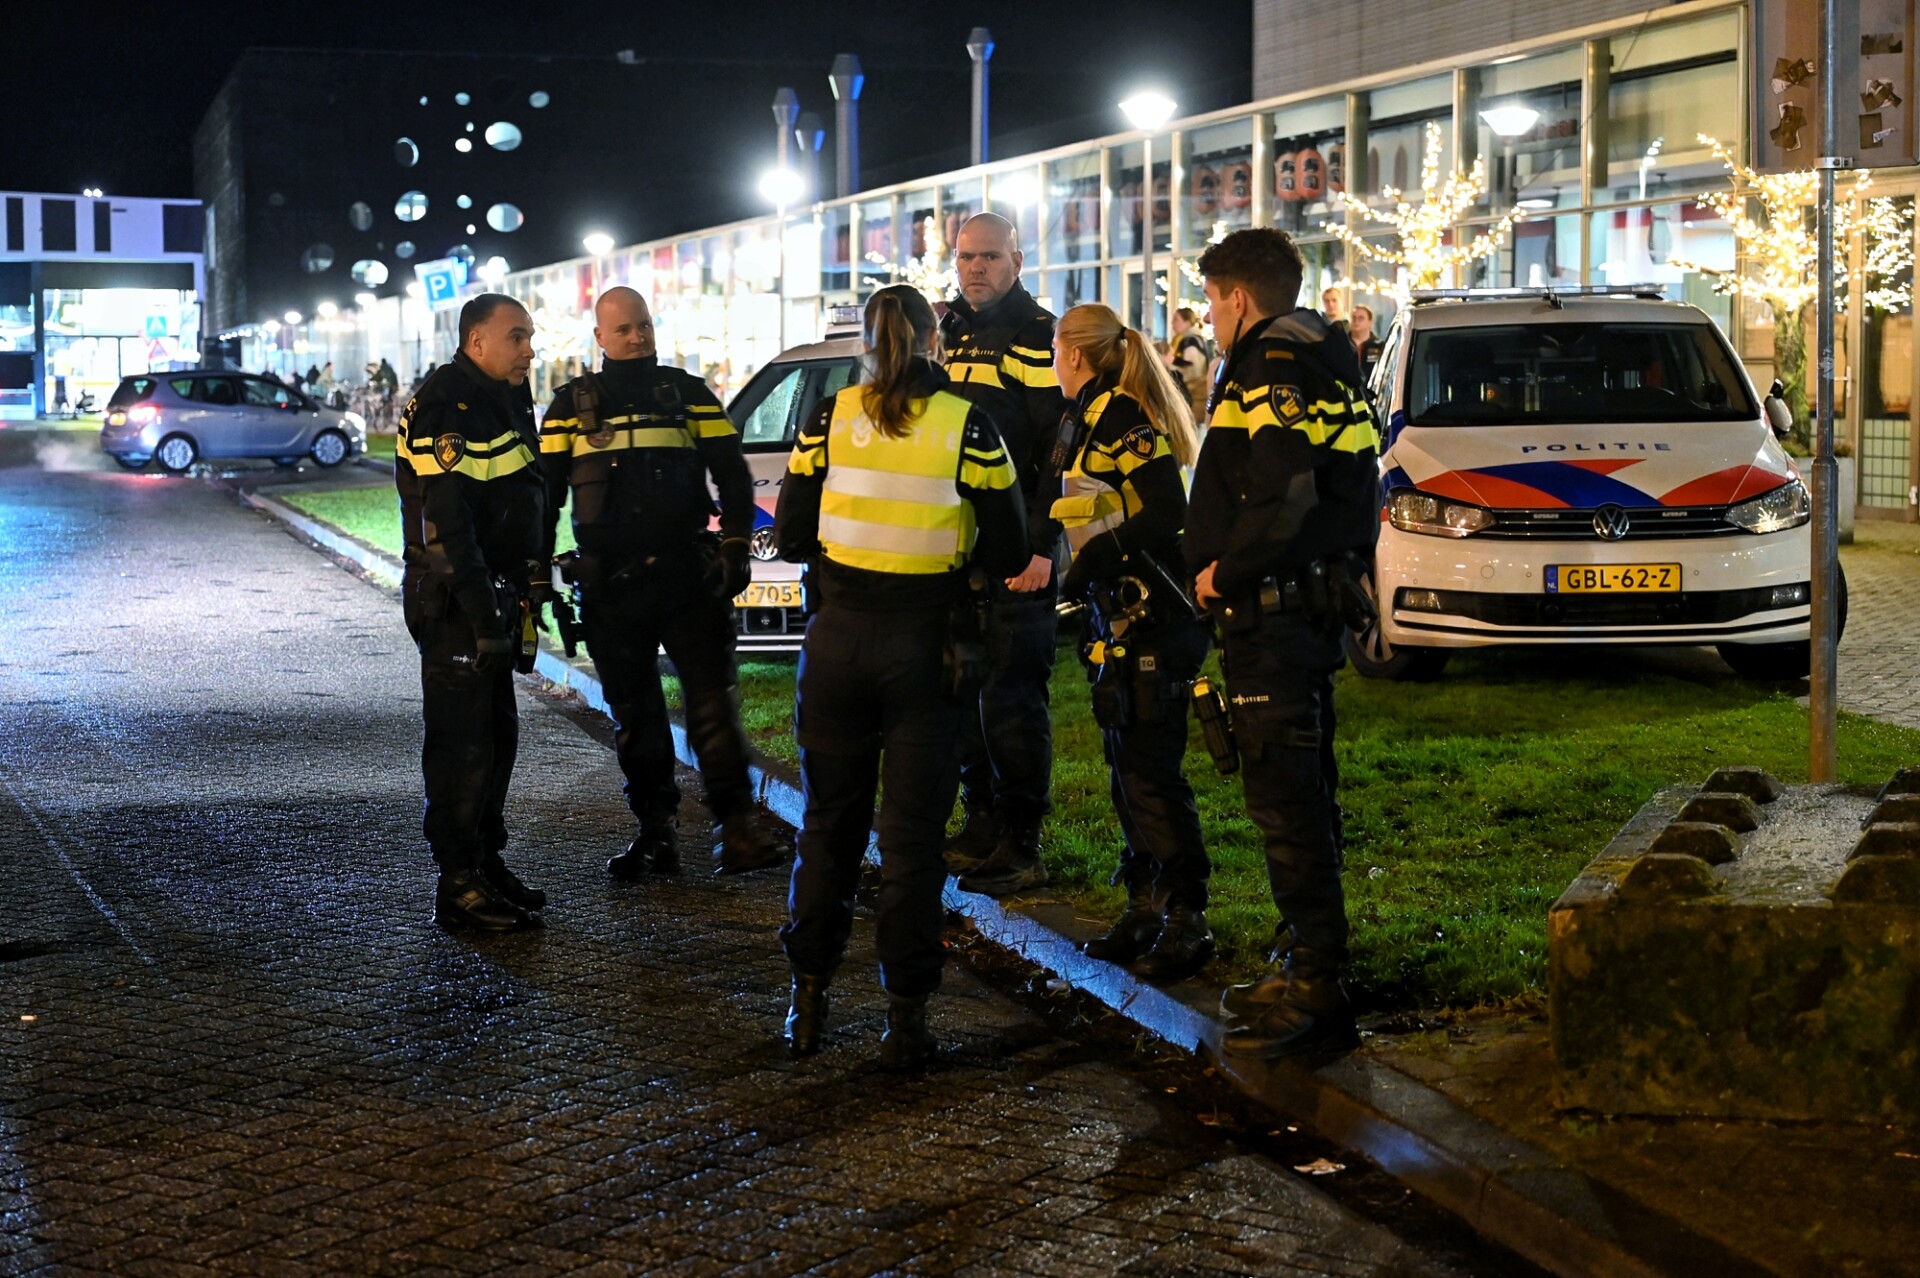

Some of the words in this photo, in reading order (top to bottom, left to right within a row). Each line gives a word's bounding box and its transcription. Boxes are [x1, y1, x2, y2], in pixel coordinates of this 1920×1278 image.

[430, 275, 447, 300] P
[1522, 442, 1671, 454] POLITIE
[1547, 581, 1557, 589] NL
[1567, 568, 1671, 589] GBL-62-Z
